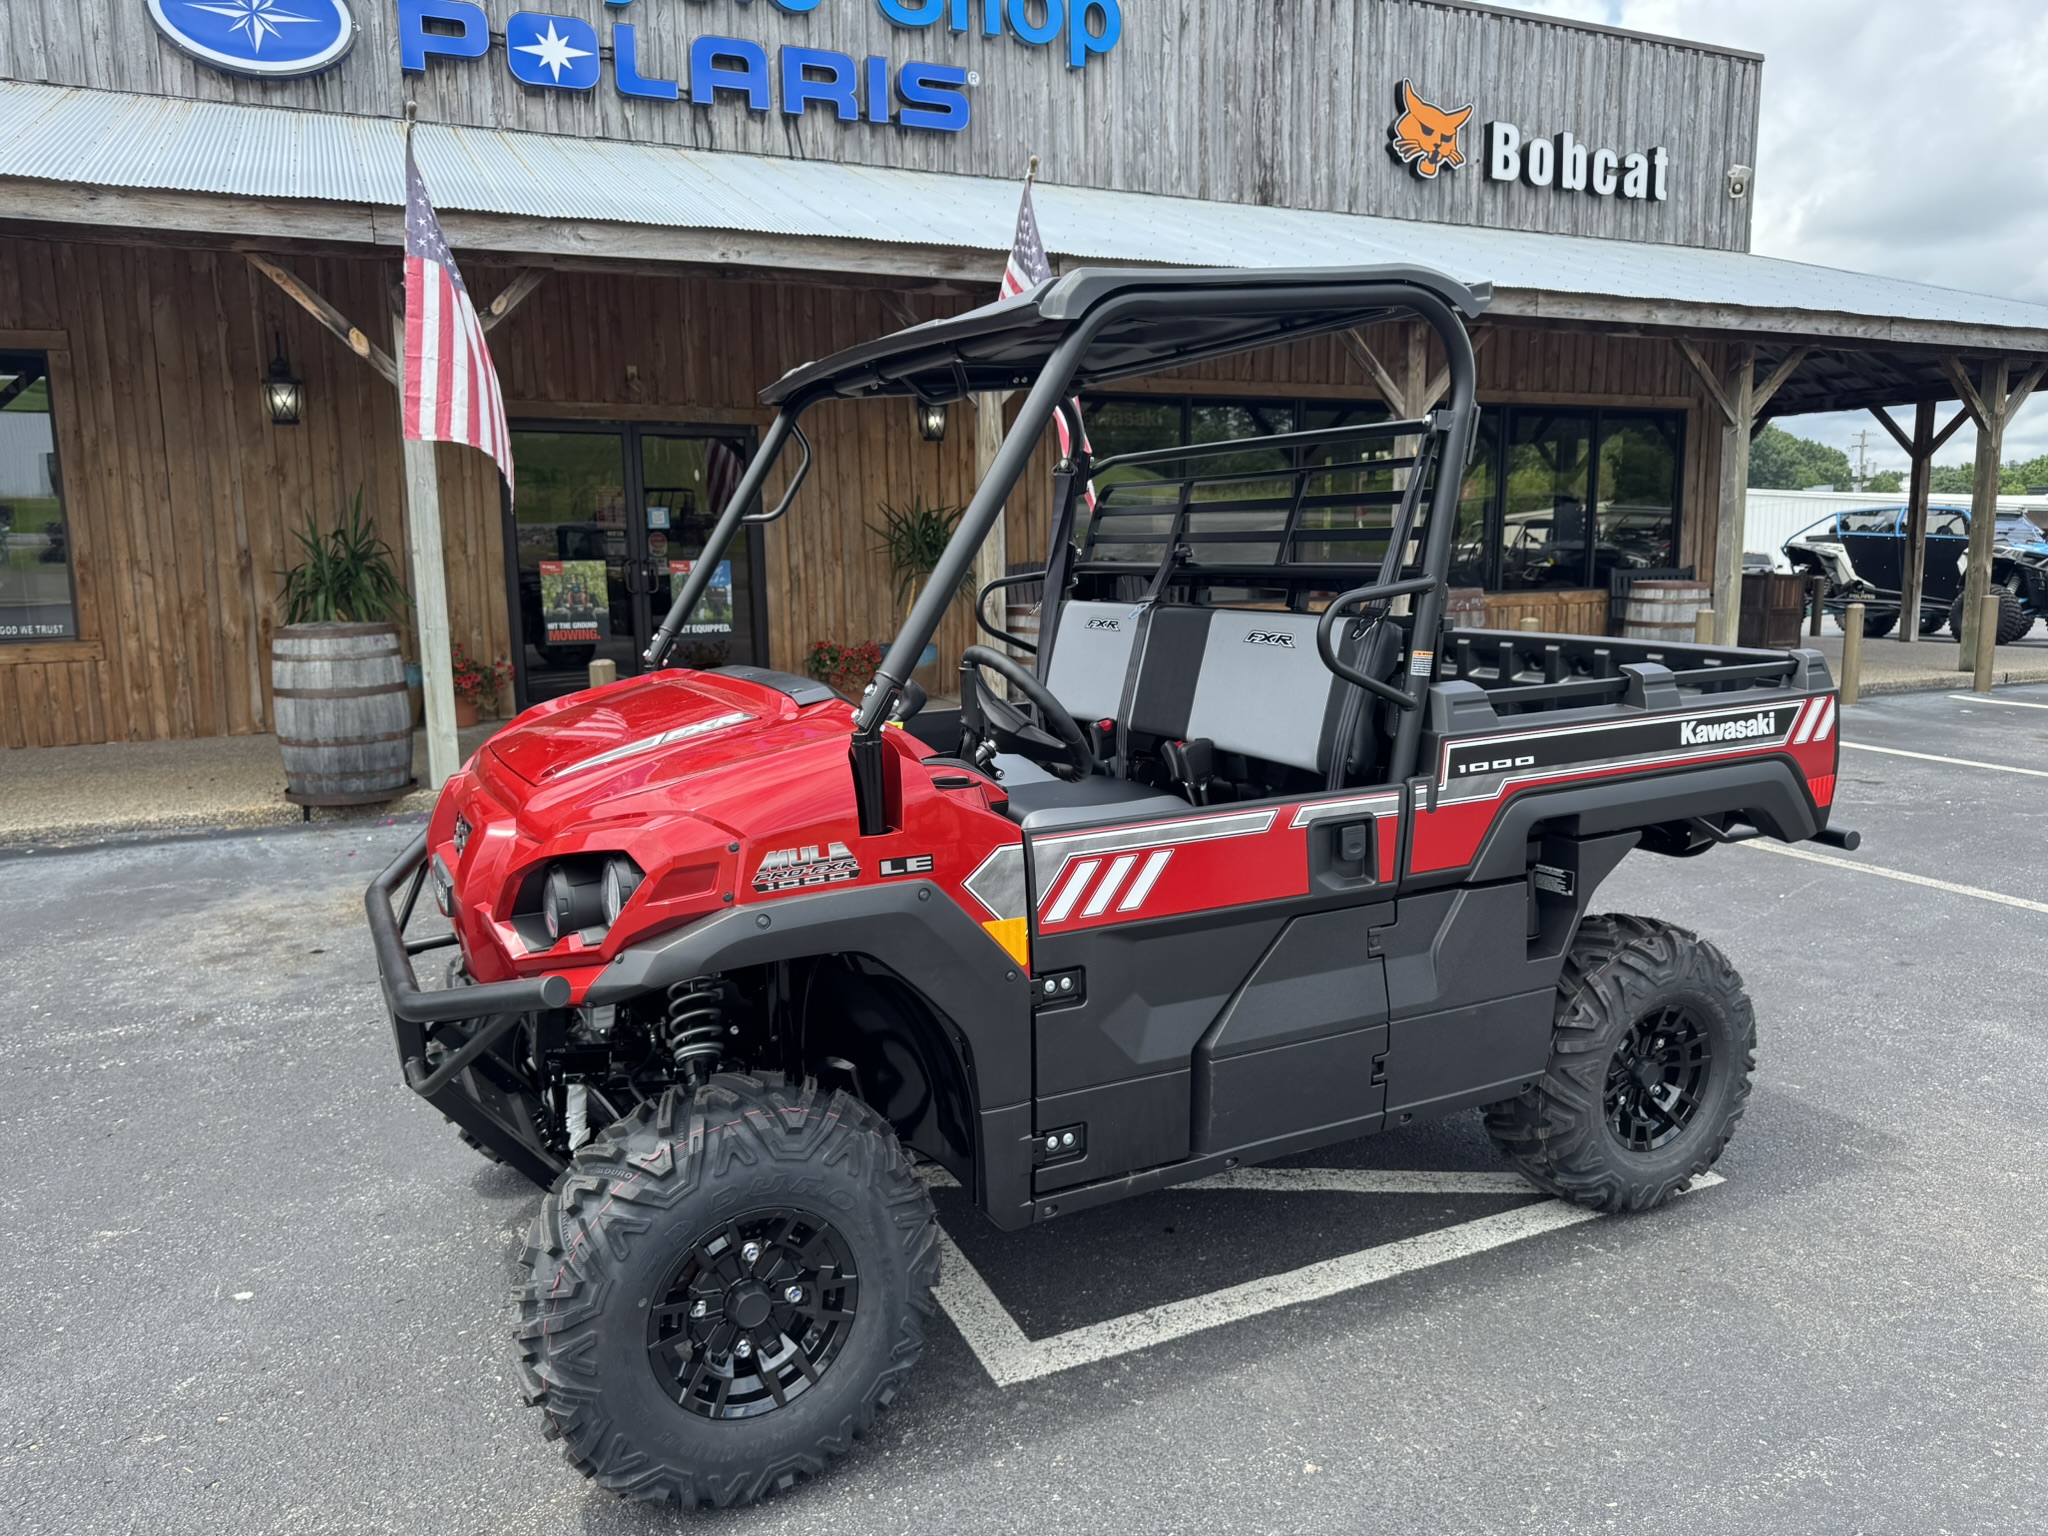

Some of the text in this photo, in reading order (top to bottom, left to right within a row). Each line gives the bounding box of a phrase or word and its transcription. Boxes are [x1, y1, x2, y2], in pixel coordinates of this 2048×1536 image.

[879, 0, 1122, 68] op
[1490, 120, 1669, 200] Bobcat
[1084, 408, 1162, 427] awasaki
[0, 624, 64, 635] GOD WE TRUST
[547, 621, 598, 630] HIT THE GROUND
[681, 624, 732, 634] ET EQUIPPED.
[1085, 617, 1121, 632] FXR
[549, 629, 601, 642] MOWING.
[1244, 630, 1296, 649] FXR
[1680, 712, 1776, 746] Kawasaki
[1457, 755, 1535, 774] 1000
[756, 841, 856, 873] MULE
[881, 855, 932, 875] LE
[752, 859, 859, 884] PRO-FXR
